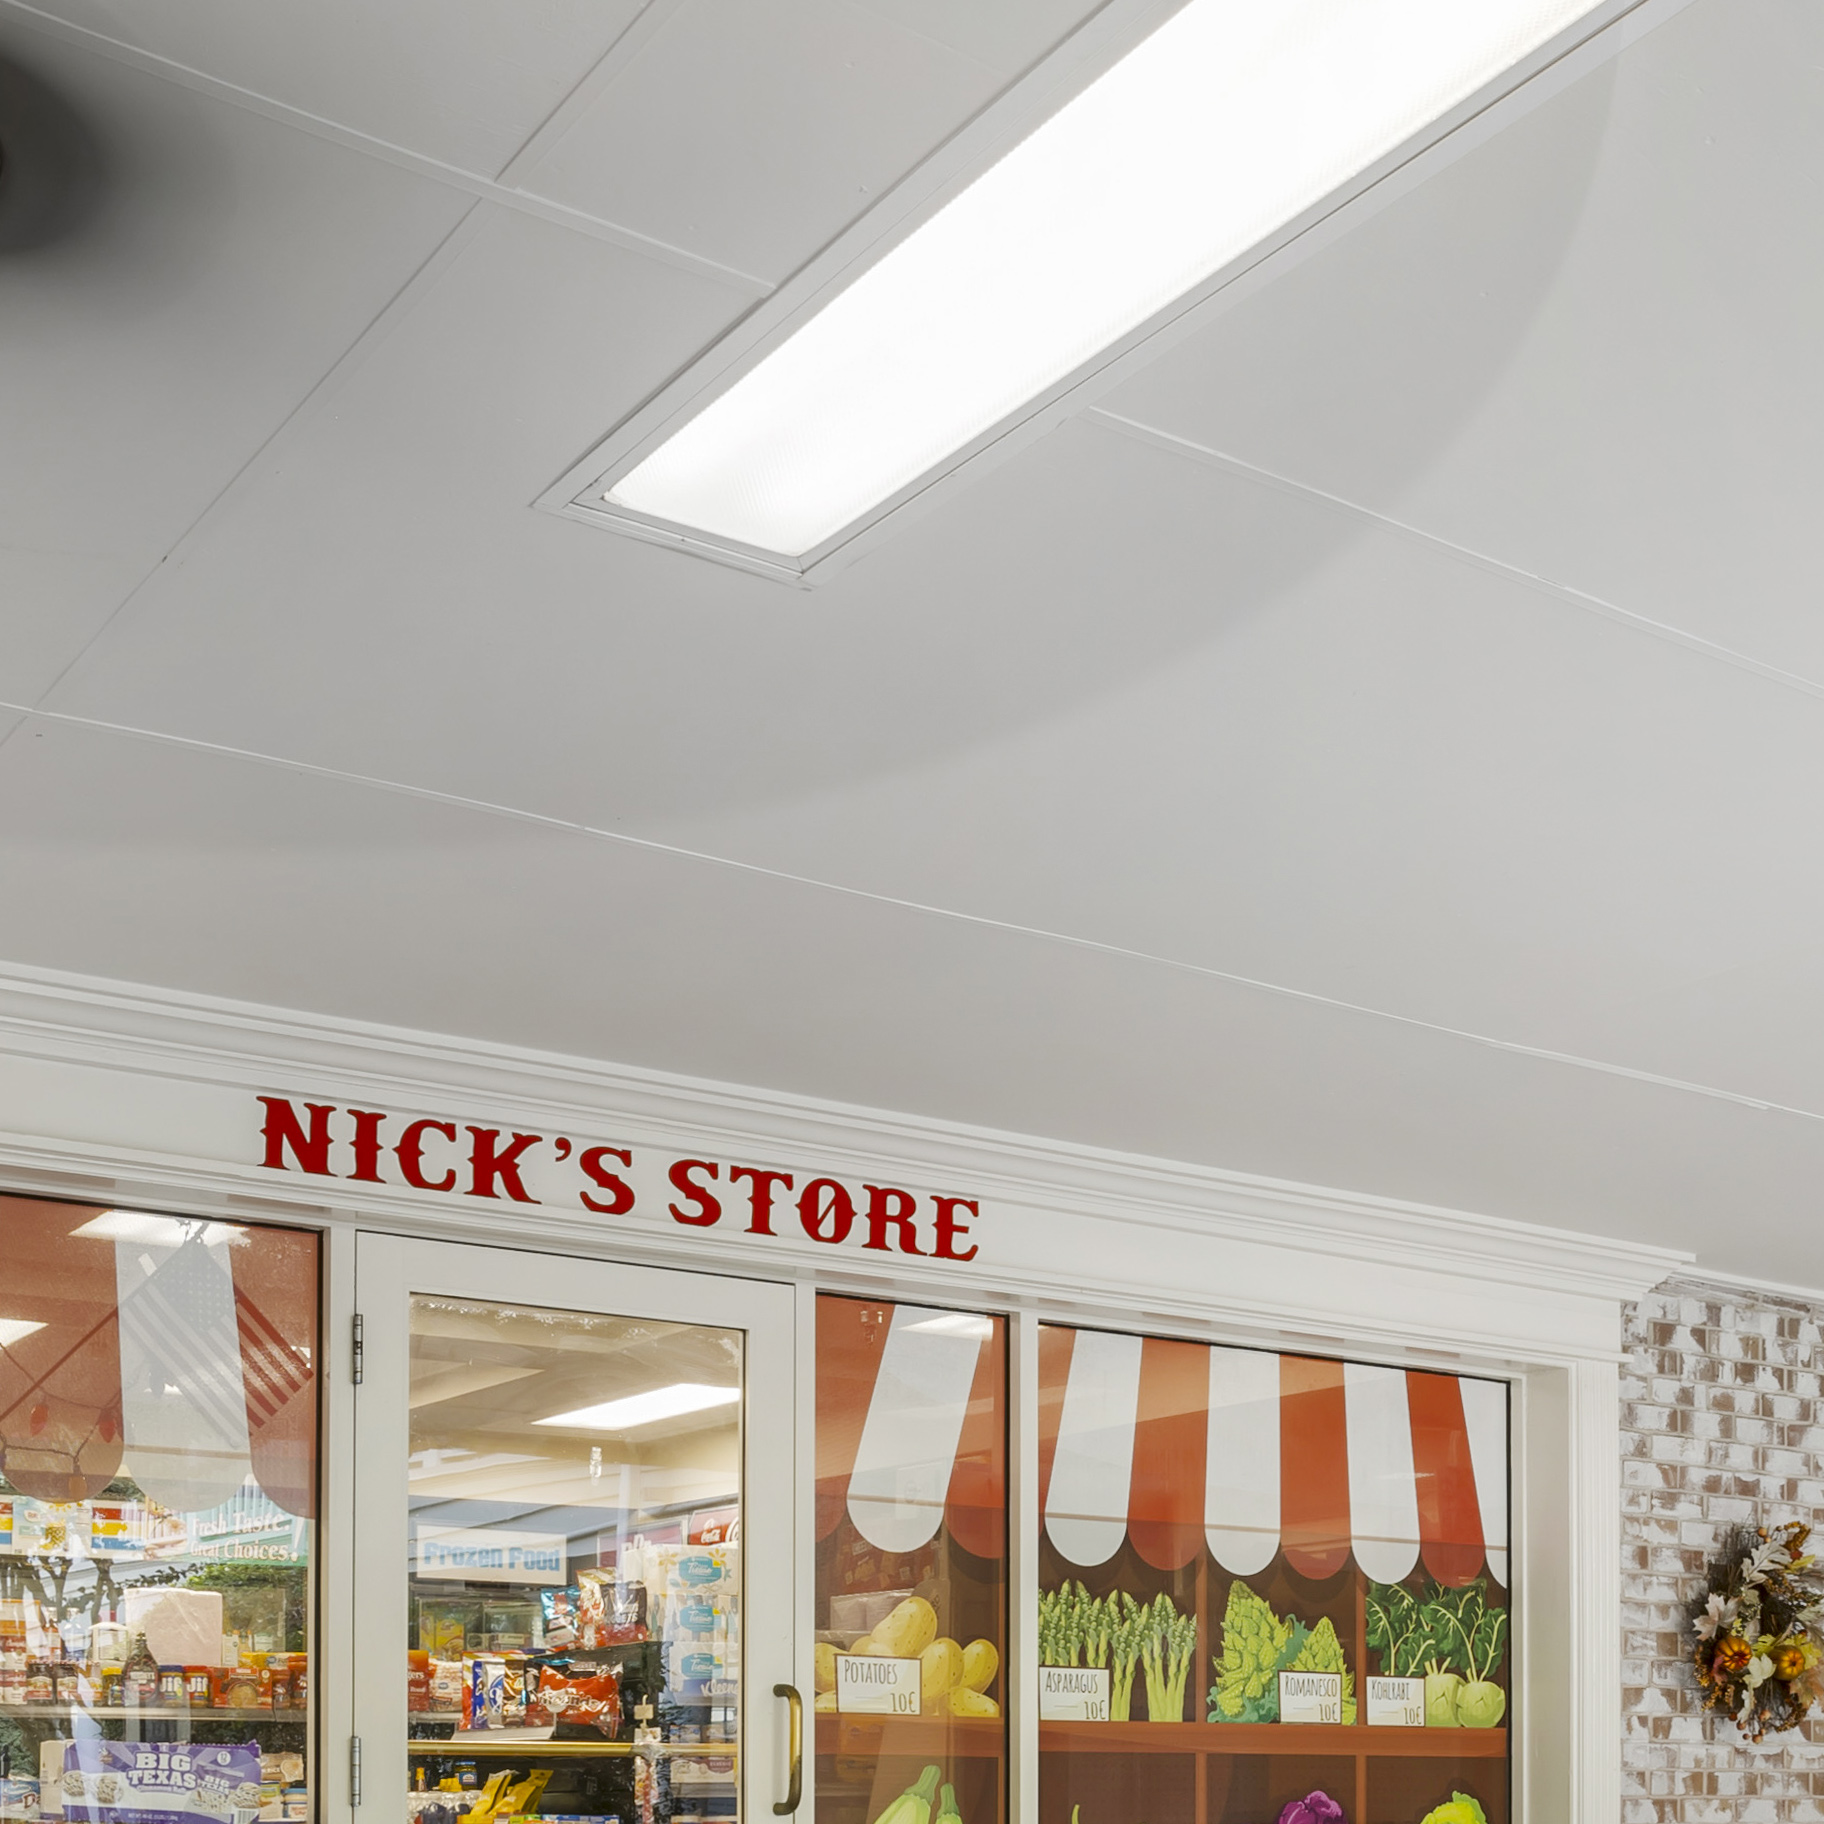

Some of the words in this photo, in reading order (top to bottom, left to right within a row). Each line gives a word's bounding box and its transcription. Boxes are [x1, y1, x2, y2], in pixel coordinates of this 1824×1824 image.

[257, 1096, 635, 1215] NICK'S
[192, 1512, 227, 1536] Fresh
[424, 1542, 503, 1568] Frozen
[508, 1547, 561, 1572] Food
[844, 1659, 898, 1684] POTATOES
[1045, 1671, 1098, 1693] ASPARAGUS
[1285, 1675, 1338, 1697] ROMANESCO
[1371, 1680, 1410, 1700] KOHLRABI
[890, 1691, 916, 1713] 10€
[1084, 1700, 1106, 1720] 10€
[1319, 1703, 1338, 1721] 10€
[1404, 1706, 1422, 1724] 10€
[136, 1752, 192, 1772] BIG
[127, 1769, 197, 1789] TEXAS
